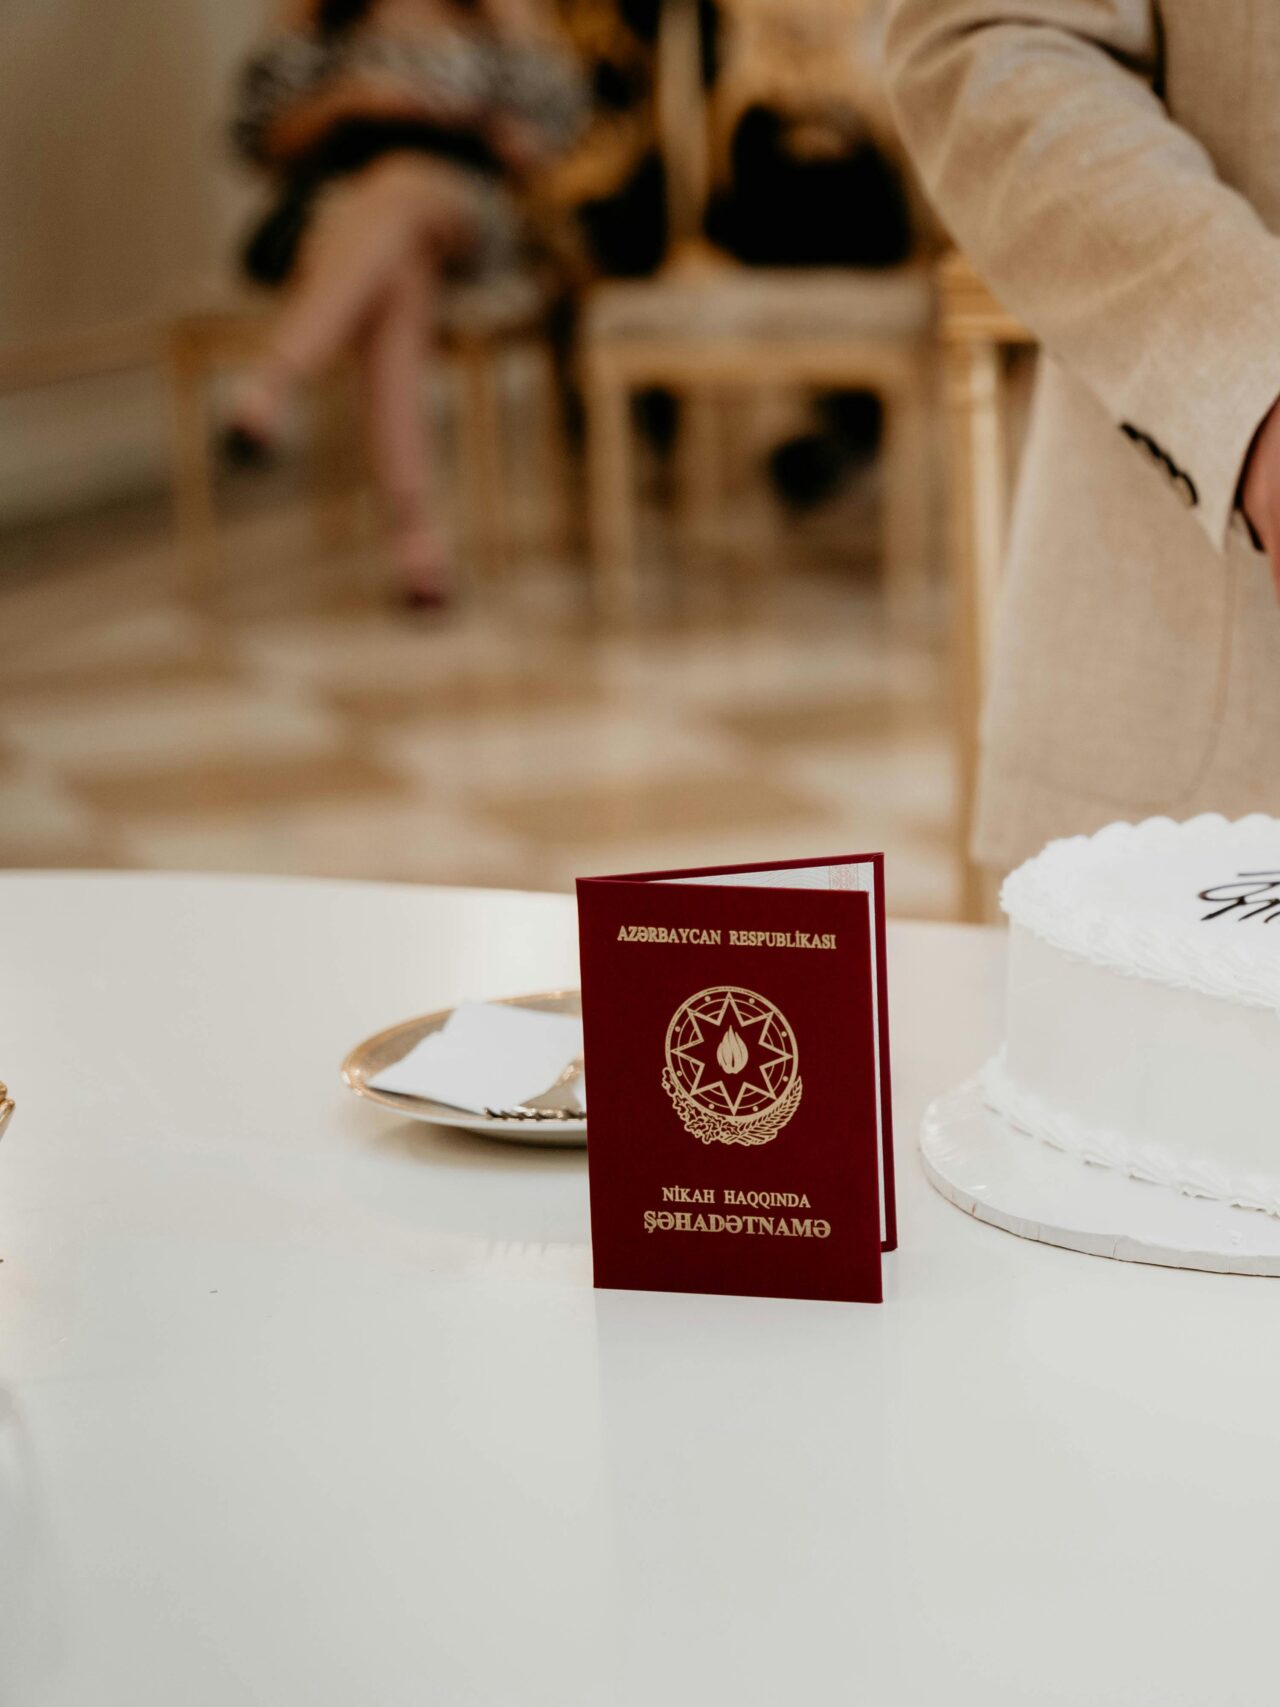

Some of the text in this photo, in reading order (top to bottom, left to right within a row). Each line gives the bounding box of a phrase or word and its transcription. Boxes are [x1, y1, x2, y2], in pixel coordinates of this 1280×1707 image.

[617, 925, 837, 949] AZƏRBAYCAN RESPUBLİKASI
[661, 1185, 811, 1209] NİKAH HAQQINDA
[643, 1210, 831, 1238] ŞƏHADƏTNAMƏ
